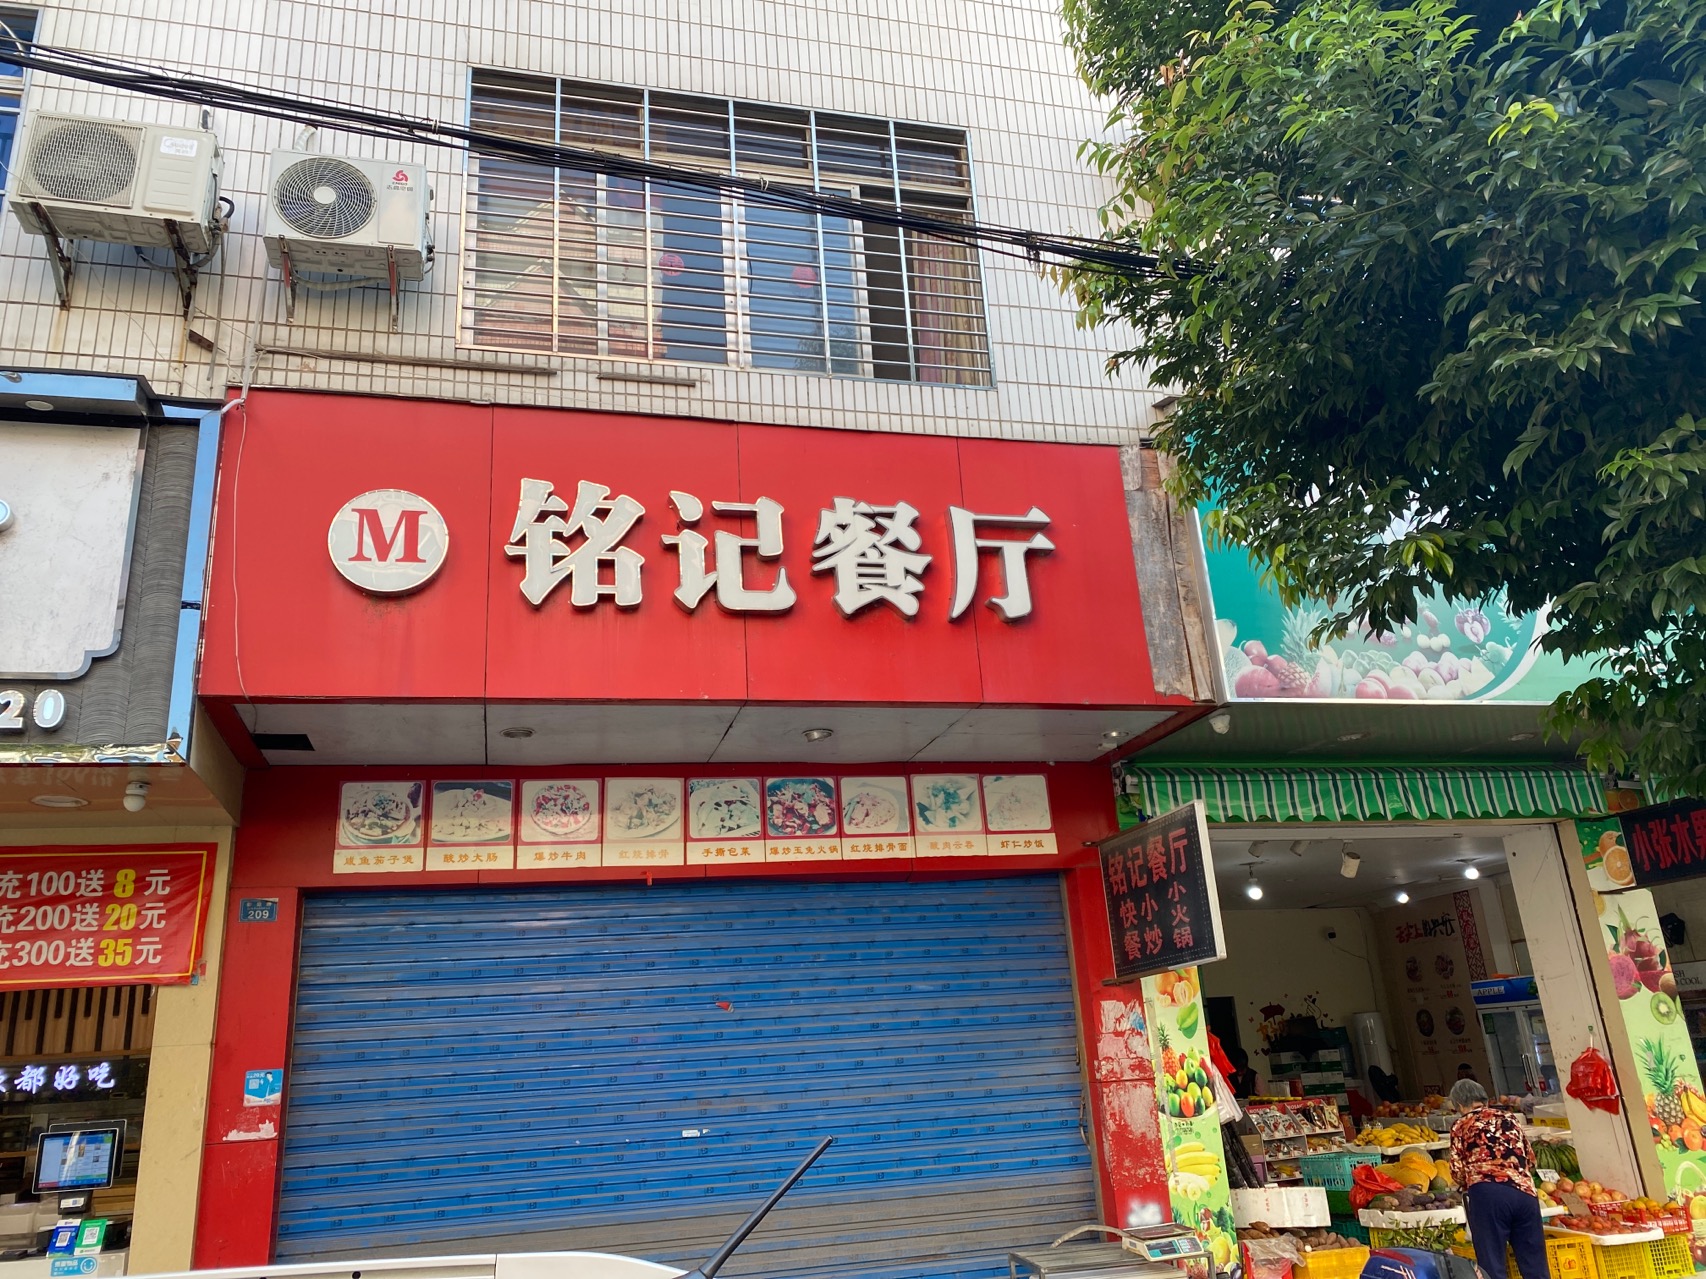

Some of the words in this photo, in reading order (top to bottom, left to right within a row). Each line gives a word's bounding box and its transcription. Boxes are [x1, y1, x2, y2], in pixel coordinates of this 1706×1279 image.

[347, 507, 428, 563] M
[504, 477, 1056, 623] 铭记餐厅
[850, 842, 908, 853] 红烧排骨面
[1000, 839, 1044, 849] 虾仁炒饭
[533, 850, 586, 862] 爆炒牛肉
[618, 848, 669, 860] 红烧排骨
[702, 846, 751, 858] 手撕包菜
[343, 854, 414, 866] 咸鱼茄子煲
[1107, 827, 1189, 896] 铭记餐厅
[247, 910, 270, 920] 209
[1167, 881, 1194, 949] 小火锅
[1120, 899, 1142, 961] 快餐
[1141, 893, 1163, 956] 小炒
[1477, 987, 1504, 996] APPLE
